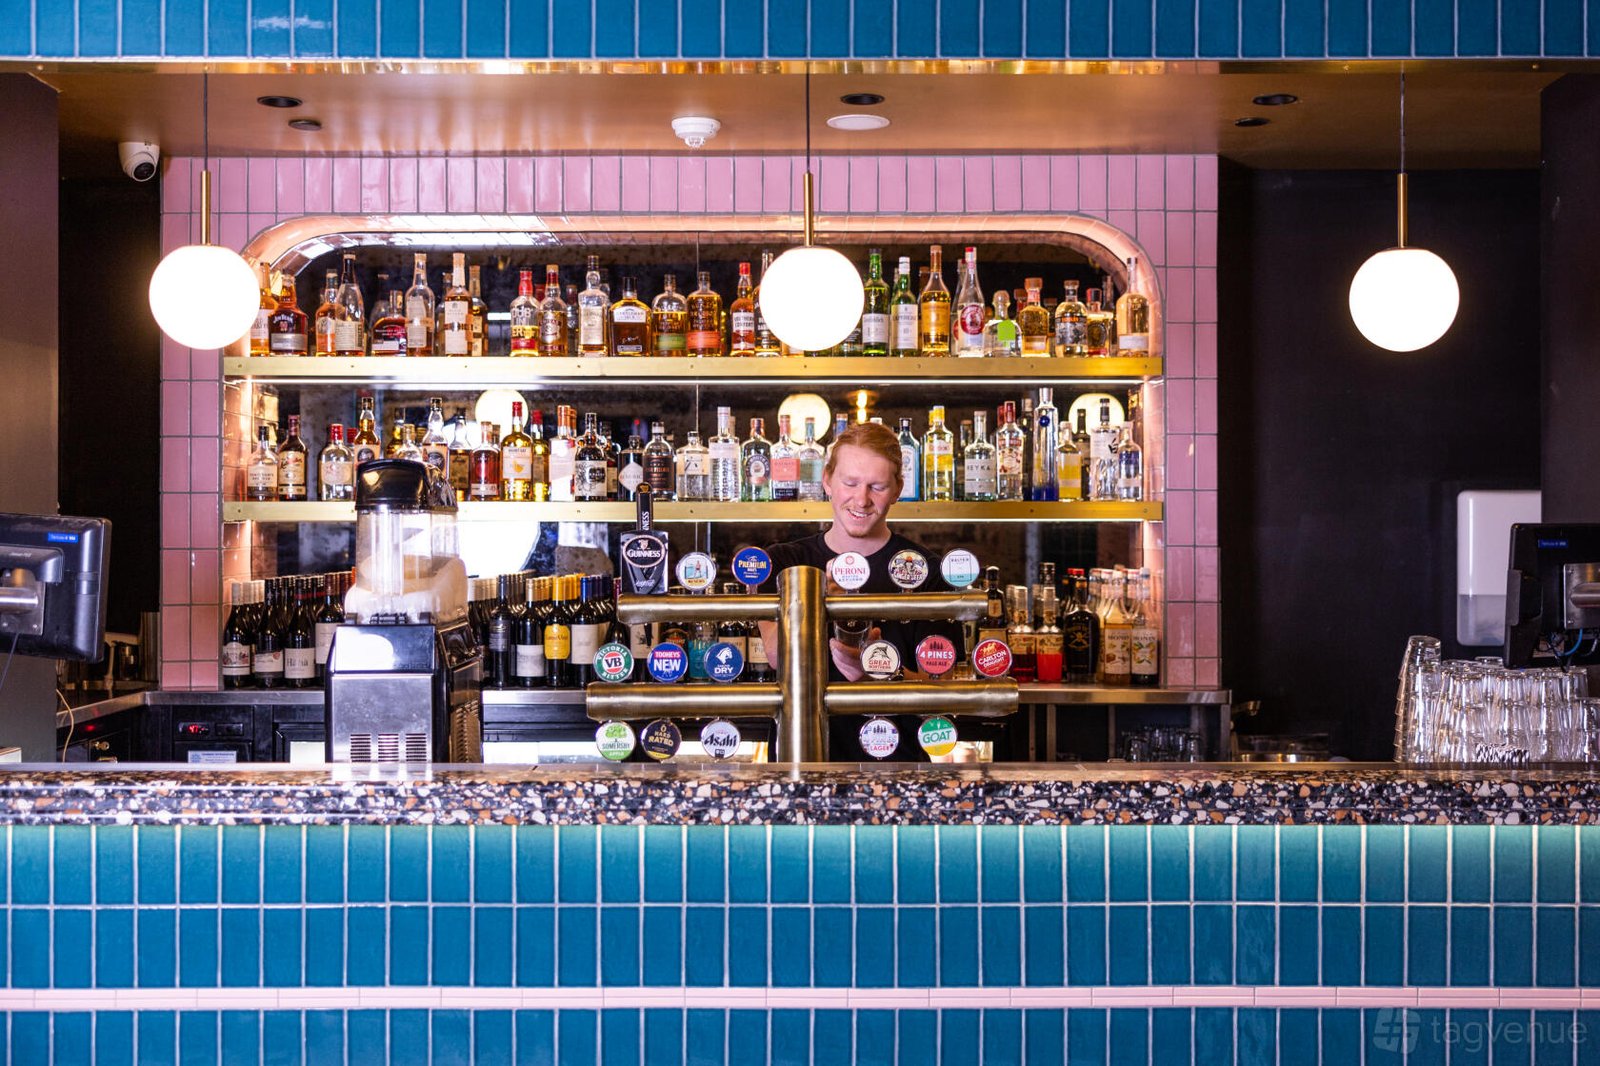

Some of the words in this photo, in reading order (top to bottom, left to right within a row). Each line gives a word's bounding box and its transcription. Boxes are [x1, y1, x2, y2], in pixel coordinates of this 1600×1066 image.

[626, 549, 661, 558] GUINNESS
[738, 560, 767, 569] PREMIUM
[834, 567, 866, 576] PERONI
[597, 645, 628, 660] VICTORIA
[654, 650, 681, 658] TOOHEYS
[978, 650, 1007, 665] CARLTON
[605, 657, 622, 668] VB
[653, 659, 681, 671] NEW
[602, 668, 629, 680] BITTER
[648, 735, 674, 747] RATED
[704, 733, 737, 748] Asahi
[922, 730, 952, 744] GOAT
